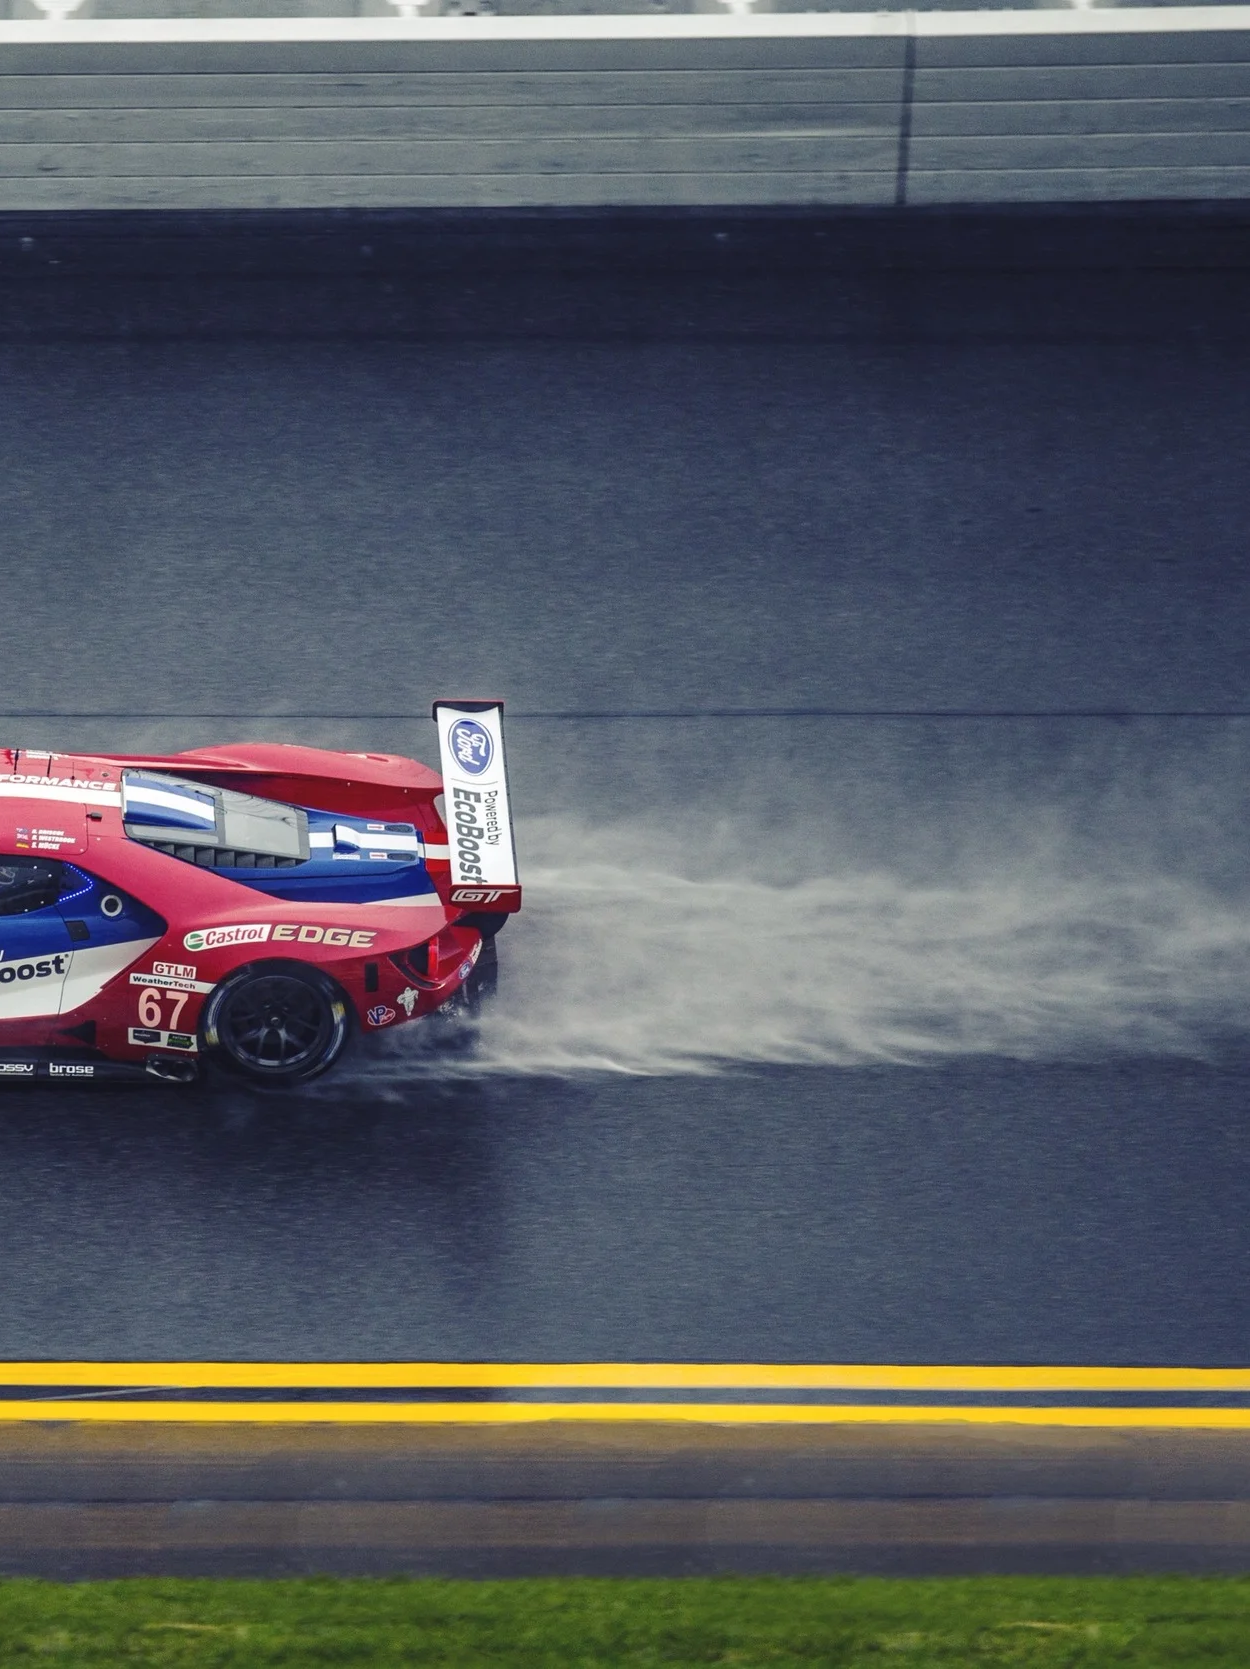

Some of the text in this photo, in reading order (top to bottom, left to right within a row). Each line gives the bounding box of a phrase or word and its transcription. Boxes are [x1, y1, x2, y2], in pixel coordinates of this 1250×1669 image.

[456, 728, 487, 766] Ford
[484, 790, 503, 847] Powered by
[453, 787, 488, 884] EcoBoost
[451, 889, 519, 904] GT
[205, 924, 378, 948] Castrol EDGE
[133, 975, 196, 990] WeatherTech
[154, 963, 194, 978] GTLM
[138, 987, 189, 1030] 67
[49, 1062, 94, 1074] brose
